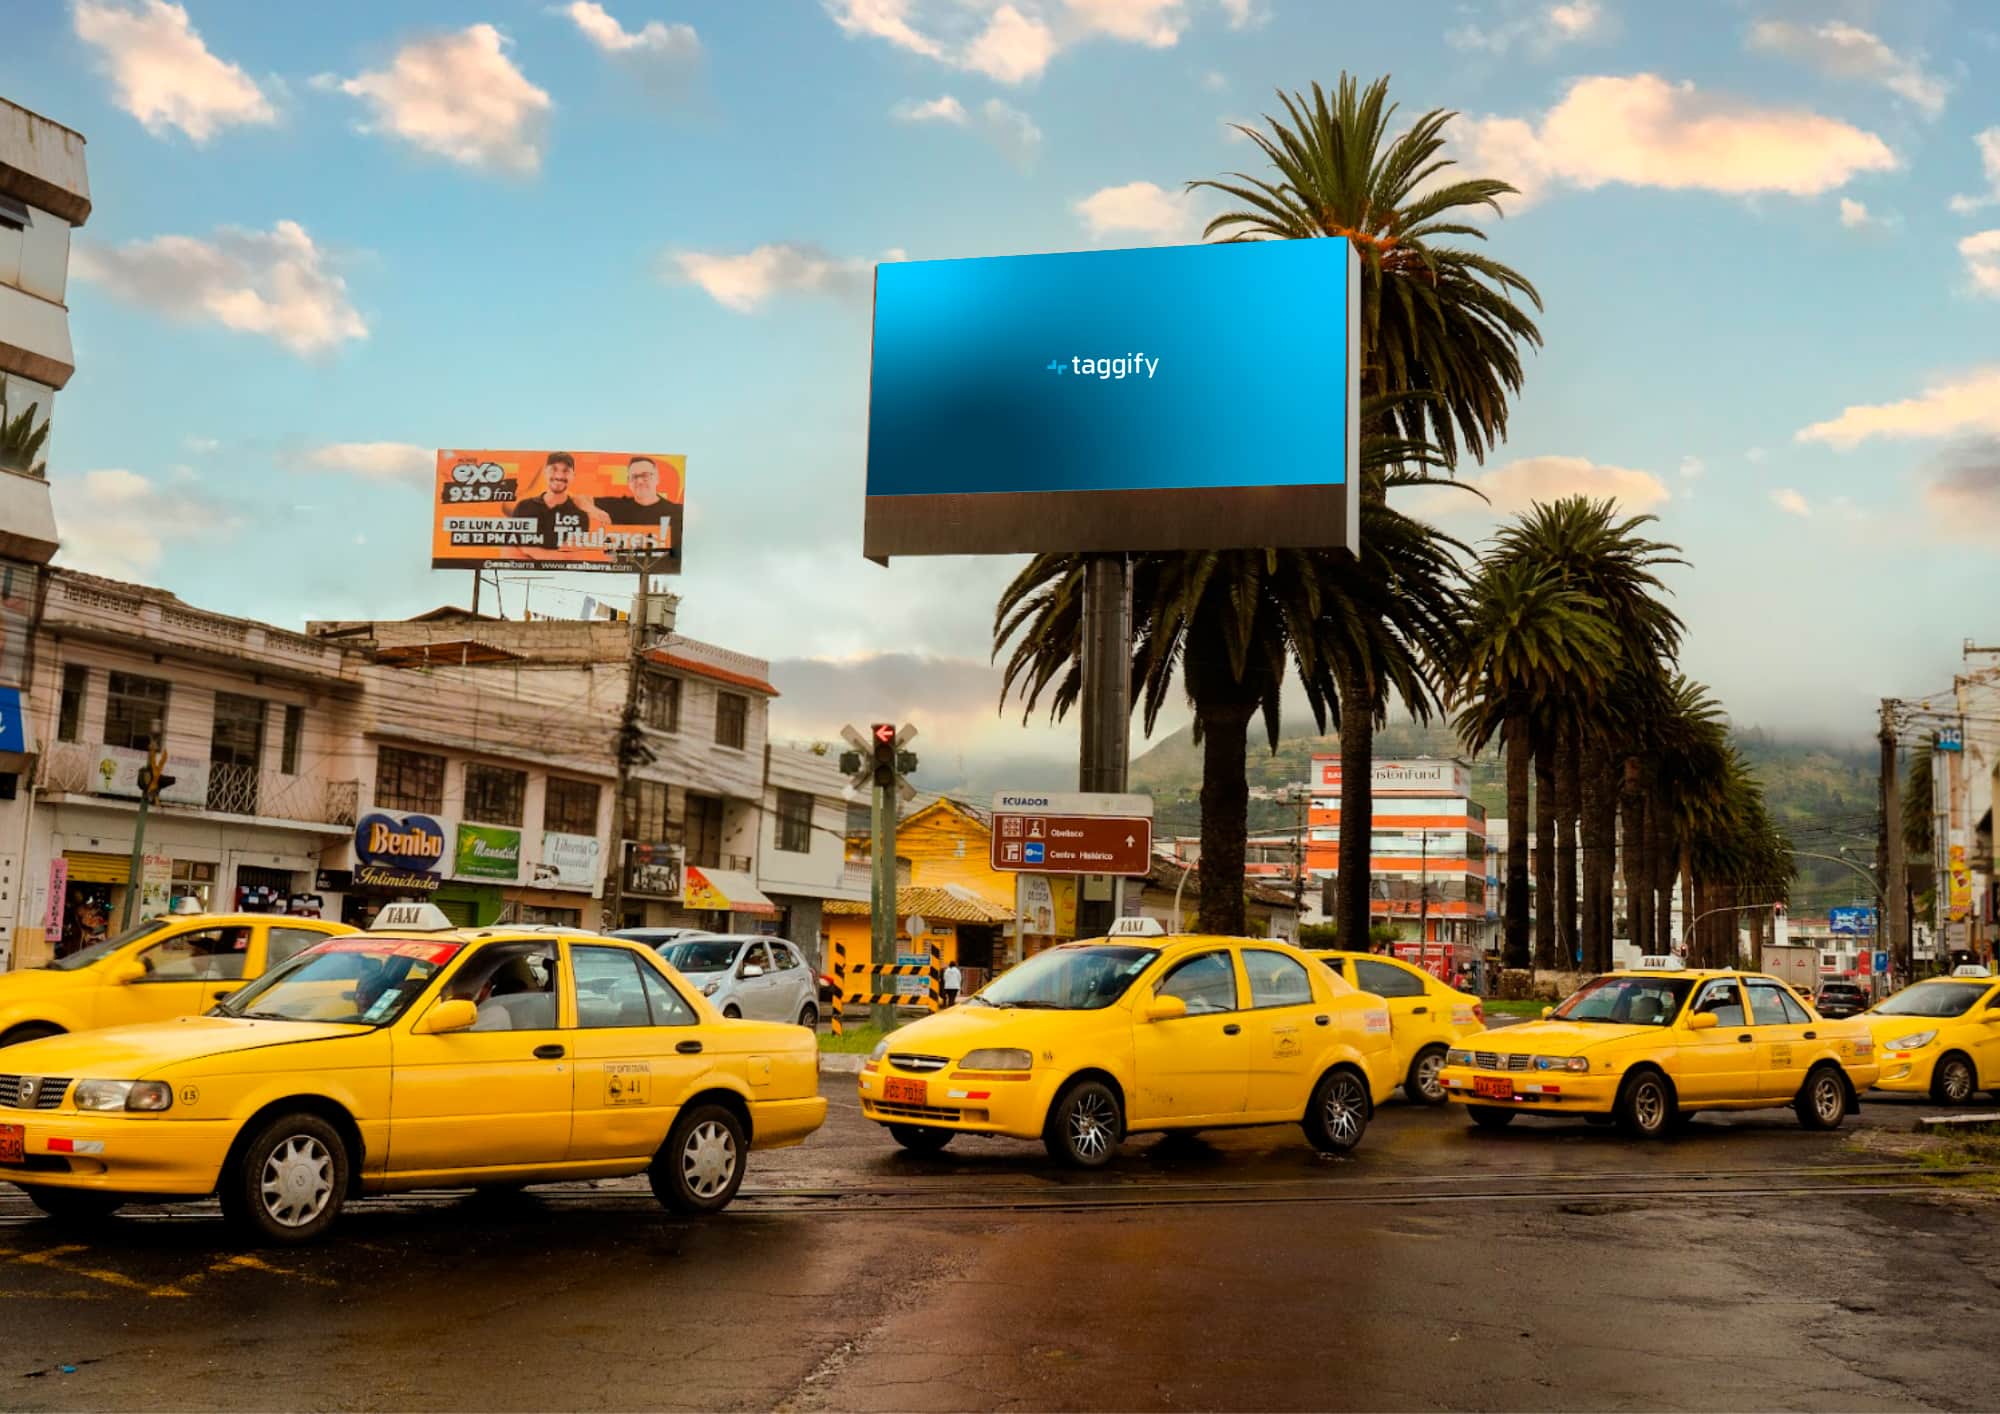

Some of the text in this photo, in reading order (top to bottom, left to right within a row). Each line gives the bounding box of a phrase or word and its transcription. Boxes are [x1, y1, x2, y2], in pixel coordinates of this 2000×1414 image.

[1072, 352, 1159, 380] taggify
[452, 463, 504, 485] exa
[449, 486, 514, 502] 93.9 fm
[449, 520, 530, 530] DE LUN A JUE
[555, 512, 580, 525] Los
[452, 532, 470, 544] DE
[473, 533, 484, 544] 12
[486, 533, 505, 544] PM
[508, 534, 518, 544] A
[1372, 767, 1441, 779] isionFund
[1002, 797, 1049, 806] ECUADOR
[355, 867, 440, 890] Intimidades
[386, 907, 422, 924] TAXI
[1120, 920, 1144, 931] TAXI
